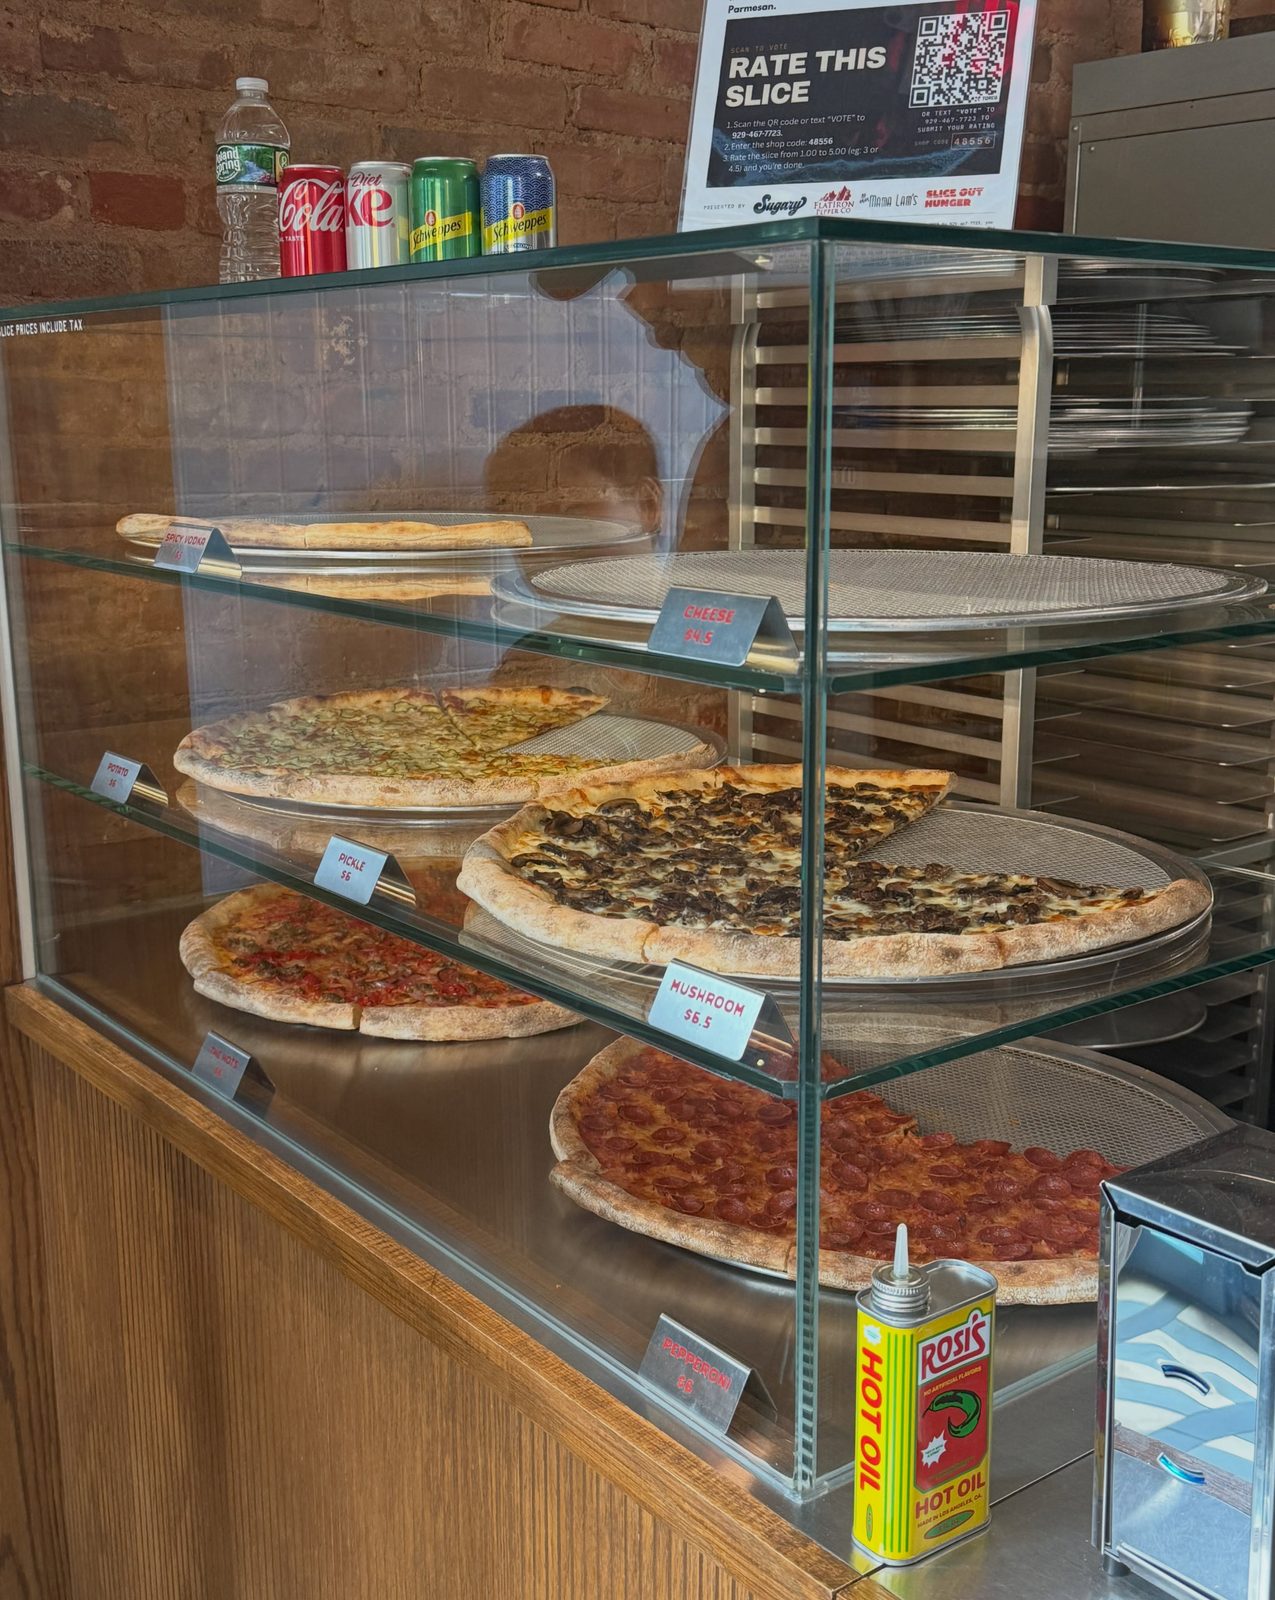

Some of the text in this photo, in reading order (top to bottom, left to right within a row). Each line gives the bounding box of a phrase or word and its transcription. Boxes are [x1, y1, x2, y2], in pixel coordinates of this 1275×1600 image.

[728, 4, 776, 14] Parmesan.
[730, 46, 750, 54] SCAN
[769, 43, 788, 51] VOTE
[728, 46, 887, 79] RATE THIS
[725, 80, 811, 108] SLICE
[767, 119, 779, 127] QR
[780, 118, 799, 126] code
[810, 116, 826, 124] text
[917, 125, 944, 133] SUBMIT
[968, 122, 995, 130] RATING
[925, 116, 977, 124] 929-467-7723
[732, 129, 783, 139] 929-467-7723.
[954, 136, 991, 145] 48556
[752, 141, 765, 149] the
[766, 140, 785, 150] shop
[786, 138, 807, 147] code:
[808, 137, 834, 146] 48556
[748, 152, 761, 160] the
[761, 152, 779, 160] slice
[780, 150, 799, 158] from
[800, 150, 818, 158] 1.00
[828, 147, 847, 156] 5.00
[863, 146, 869, 154] 3
[743, 163, 758, 172] and
[759, 161, 782, 173] you're
[783, 160, 805, 169] done.
[350, 171, 383, 187] Diet
[926, 187, 984, 198] SLICE OUT
[279, 178, 344, 233] Cola
[753, 194, 808, 217] Sugary
[814, 201, 855, 209] FLATIRON
[924, 199, 971, 208] HUNGER
[412, 219, 462, 250] Schweppes
[493, 213, 547, 243] Schweppes
[16, 323, 39, 336] PRICES
[39, 320, 68, 334] INCLUDE
[70, 319, 83, 331] TAX
[166, 533, 207, 546] SPICY VODKA
[683, 605, 736, 624] CHEESE
[684, 628, 714, 646] $4.5
[107, 762, 129, 777] POTATO
[338, 852, 366, 872] PICKLE
[340, 870, 352, 882] $6
[670, 978, 746, 1018] MUSHROOM
[683, 1008, 713, 1030] $6.5
[661, 1336, 734, 1393] PEPPERONI
[923, 1365, 982, 1397] NO ARTIFICIAL FLAVORS
[861, 1346, 883, 1435] HOT
[860, 1434, 881, 1492] OIL
[915, 1471, 986, 1520] HOT OIL
[917, 1516, 932, 1528] MADE
